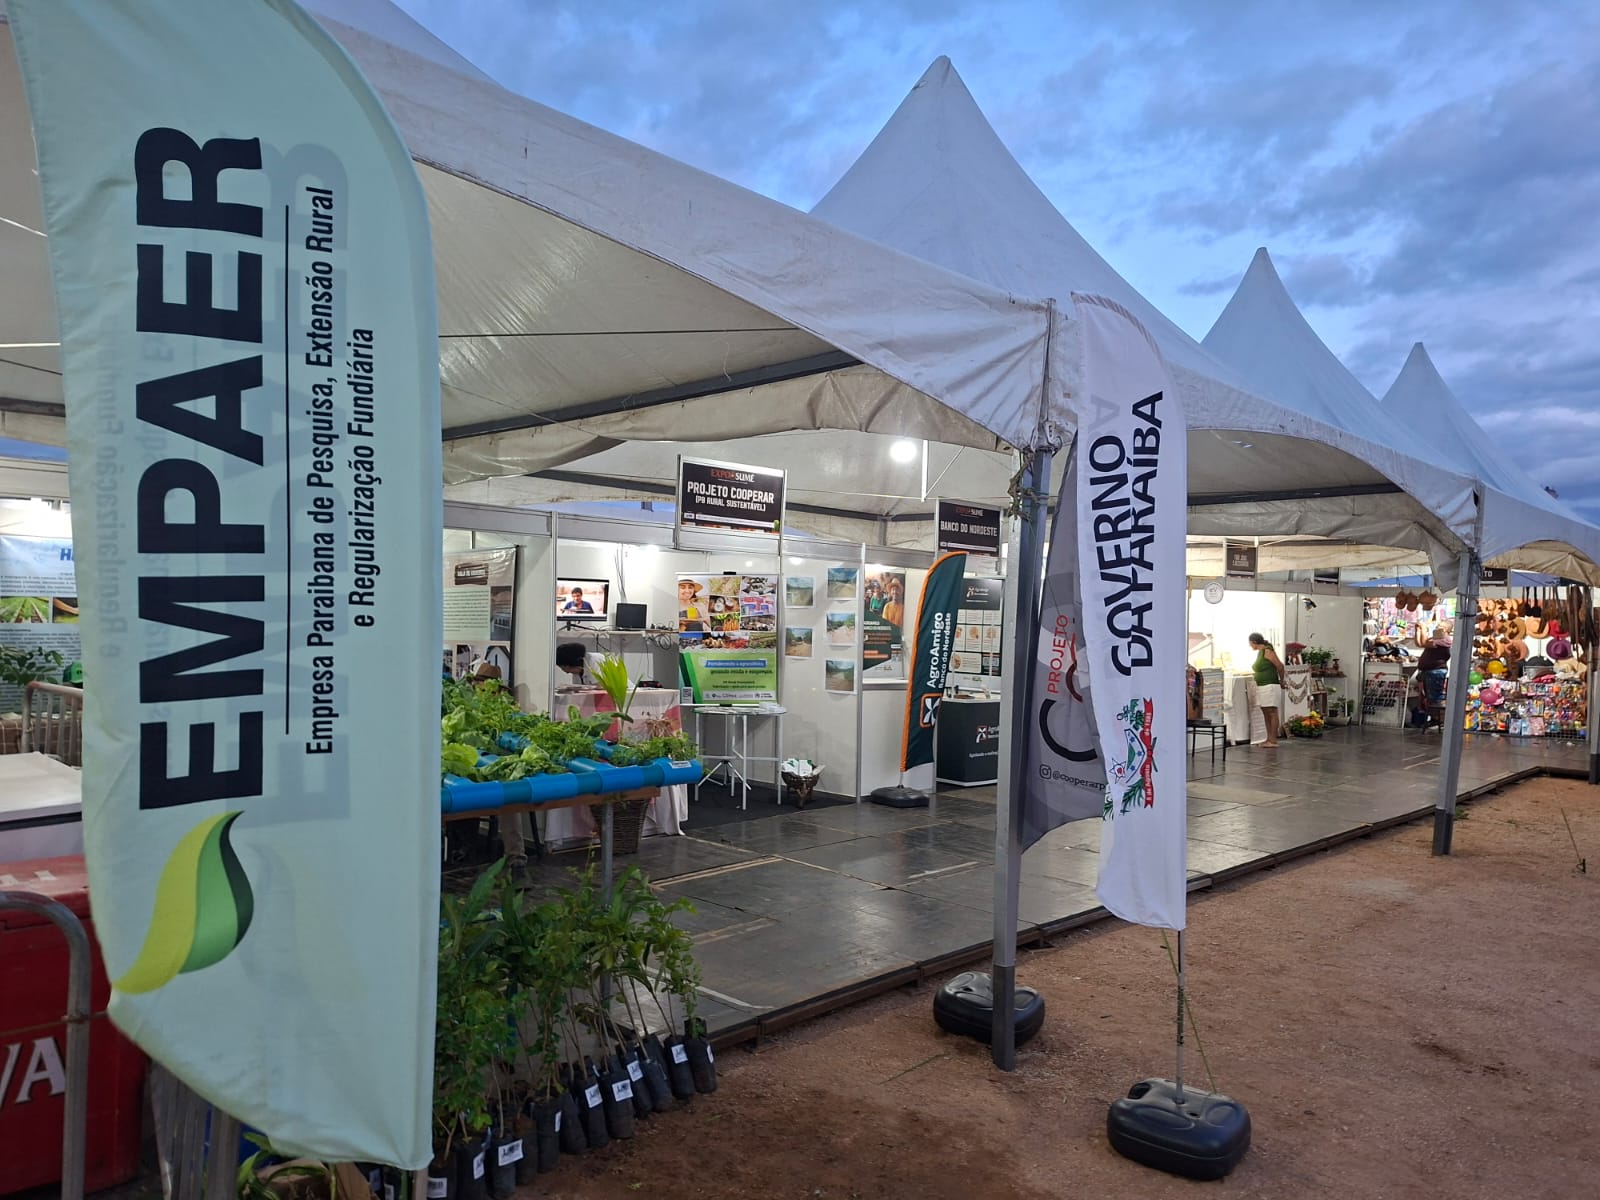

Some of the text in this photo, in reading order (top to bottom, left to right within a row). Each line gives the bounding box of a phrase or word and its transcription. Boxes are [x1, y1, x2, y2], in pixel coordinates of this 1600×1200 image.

[135, 128, 264, 810] EMPAER
[306, 187, 339, 754] Empresa Paraibana de Pesquisa, Extensão Rural
[347, 329, 381, 626] e Regularização Fundiária
[687, 481, 774, 504] PROJETO COOPERAR
[706, 497, 725, 507] RURAL
[940, 520, 959, 532] BANCO
[960, 523, 968, 533] DO
[1089, 436, 1132, 675] GOVERNO
[1127, 391, 1163, 667] DA PARAÍBA
[926, 612, 945, 688] AgroAmigo
[938, 664, 947, 688] Banco
[943, 612, 952, 651] Nordeste
[1047, 614, 1069, 694] PROJETO
[1053, 770, 1106, 791] @cooperarp
